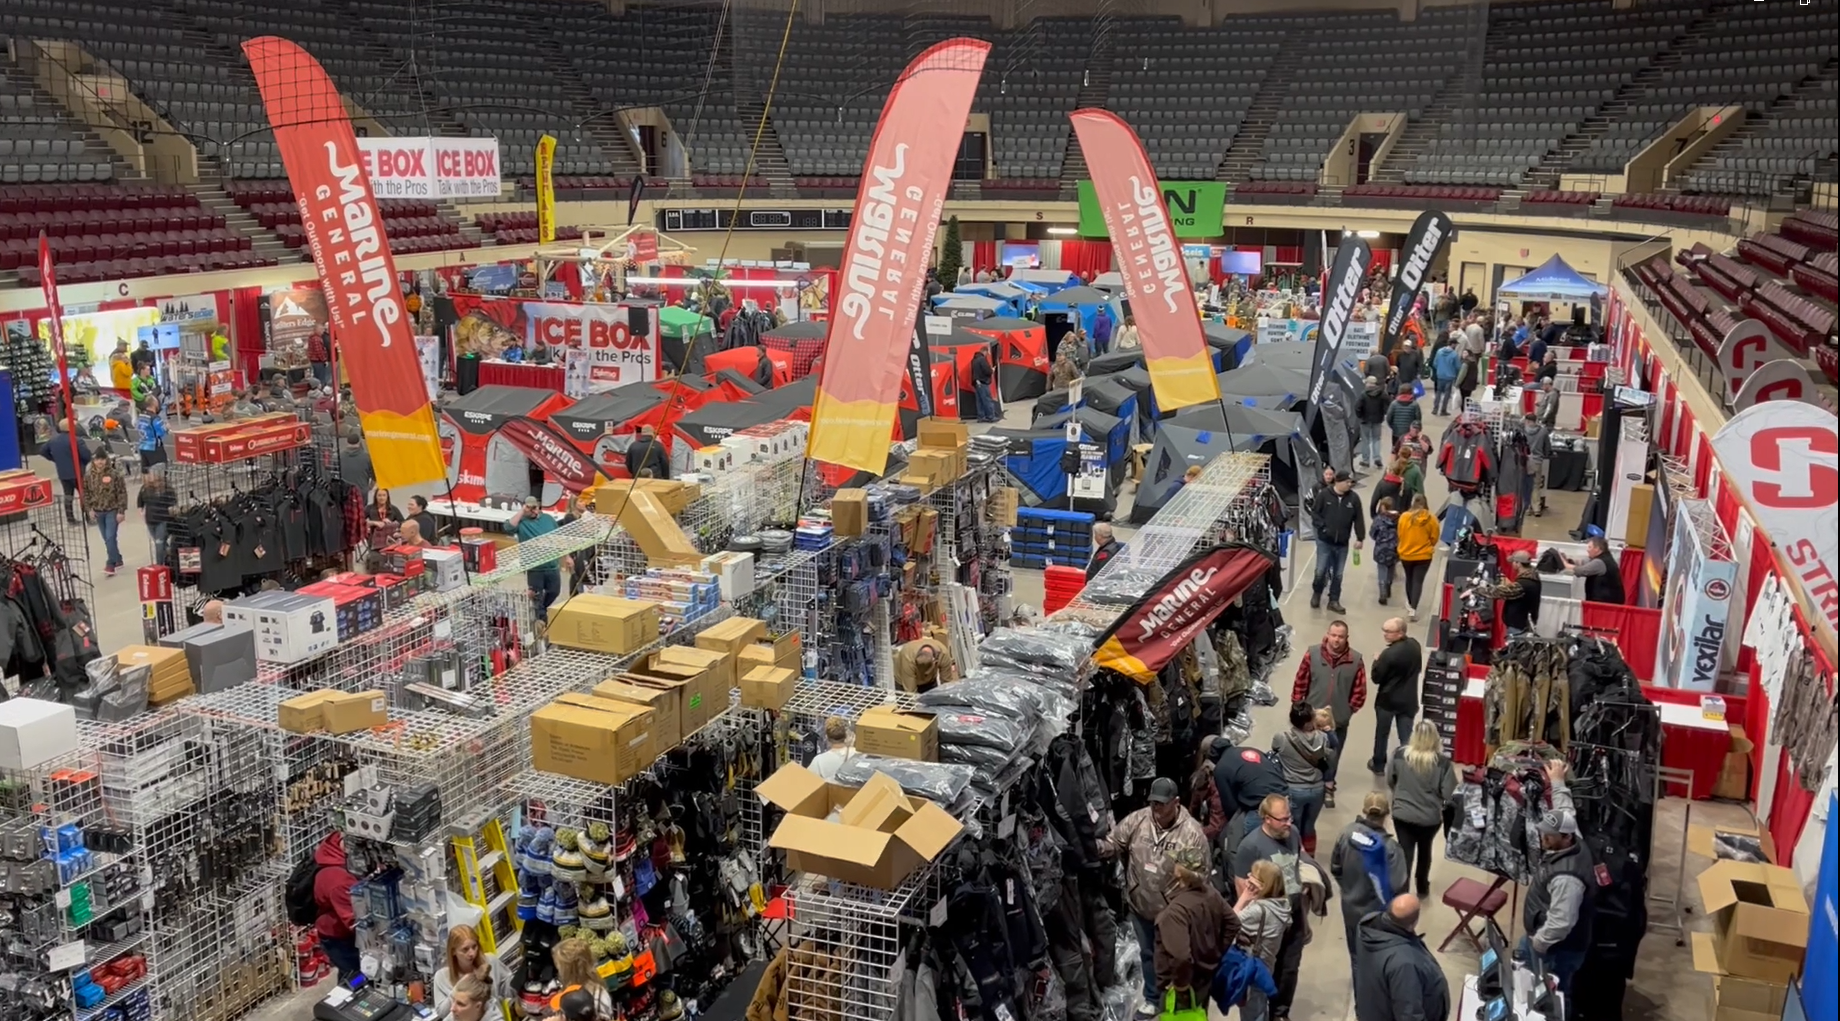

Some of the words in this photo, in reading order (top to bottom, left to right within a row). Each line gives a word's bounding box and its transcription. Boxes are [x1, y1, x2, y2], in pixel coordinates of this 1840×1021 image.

[131, 121, 153, 144] 12
[1348, 139, 1355, 155] 3
[378, 148, 426, 178] BOX
[436, 150, 461, 177] ICE
[464, 149, 496, 177] BOX
[371, 179, 383, 195] ith
[387, 179, 402, 195] the
[405, 180, 427, 195] Pros
[437, 179, 452, 195] Talk
[454, 179, 469, 195] with
[469, 179, 482, 194] the
[483, 179, 498, 194] Pros
[1036, 211, 1044, 221] S
[1246, 216, 1254, 225] R
[306, 221, 327, 276] Outdoors
[322, 278, 335, 303] with
[316, 185, 366, 326] GENERAL
[459, 252, 466, 262] A
[1400, 216, 1442, 291] Otter
[118, 283, 129, 296] C
[1323, 247, 1364, 350] Otter
[534, 316, 583, 347] ICE
[1388, 306, 1404, 336] Otter
[596, 350, 618, 363] the
[621, 351, 652, 364] Pros
